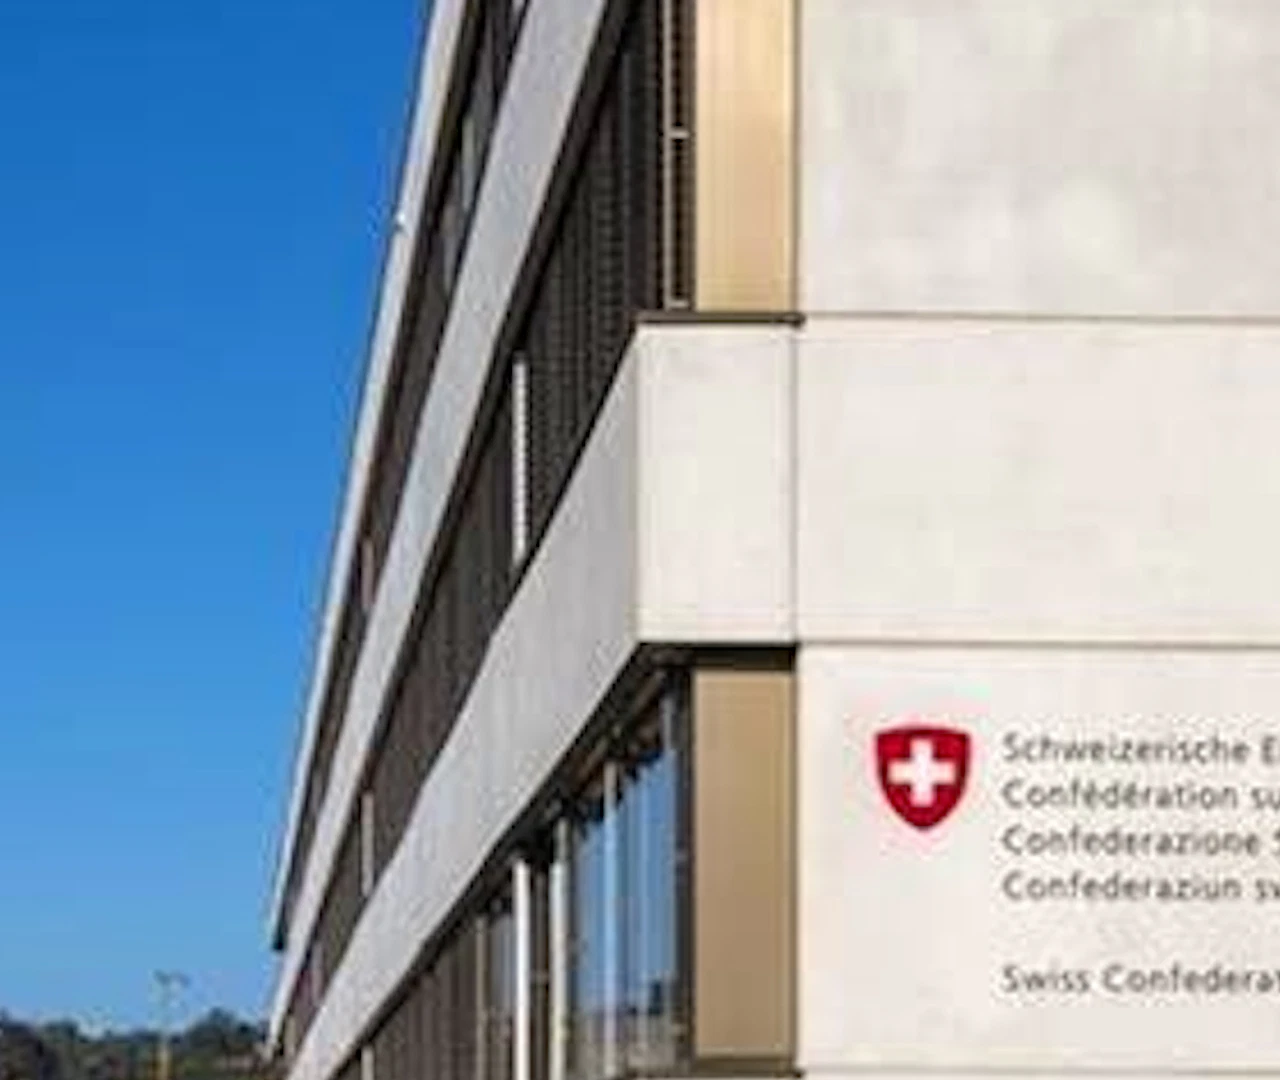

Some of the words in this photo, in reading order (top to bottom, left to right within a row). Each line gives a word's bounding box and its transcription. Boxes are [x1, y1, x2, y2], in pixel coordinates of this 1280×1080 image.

[1002, 731, 1251, 766] Schweizerische
[1000, 823, 1262, 858] Confederazione
[1001, 869, 1243, 903] Confederaziun
[1003, 964, 1091, 995] Swiss
